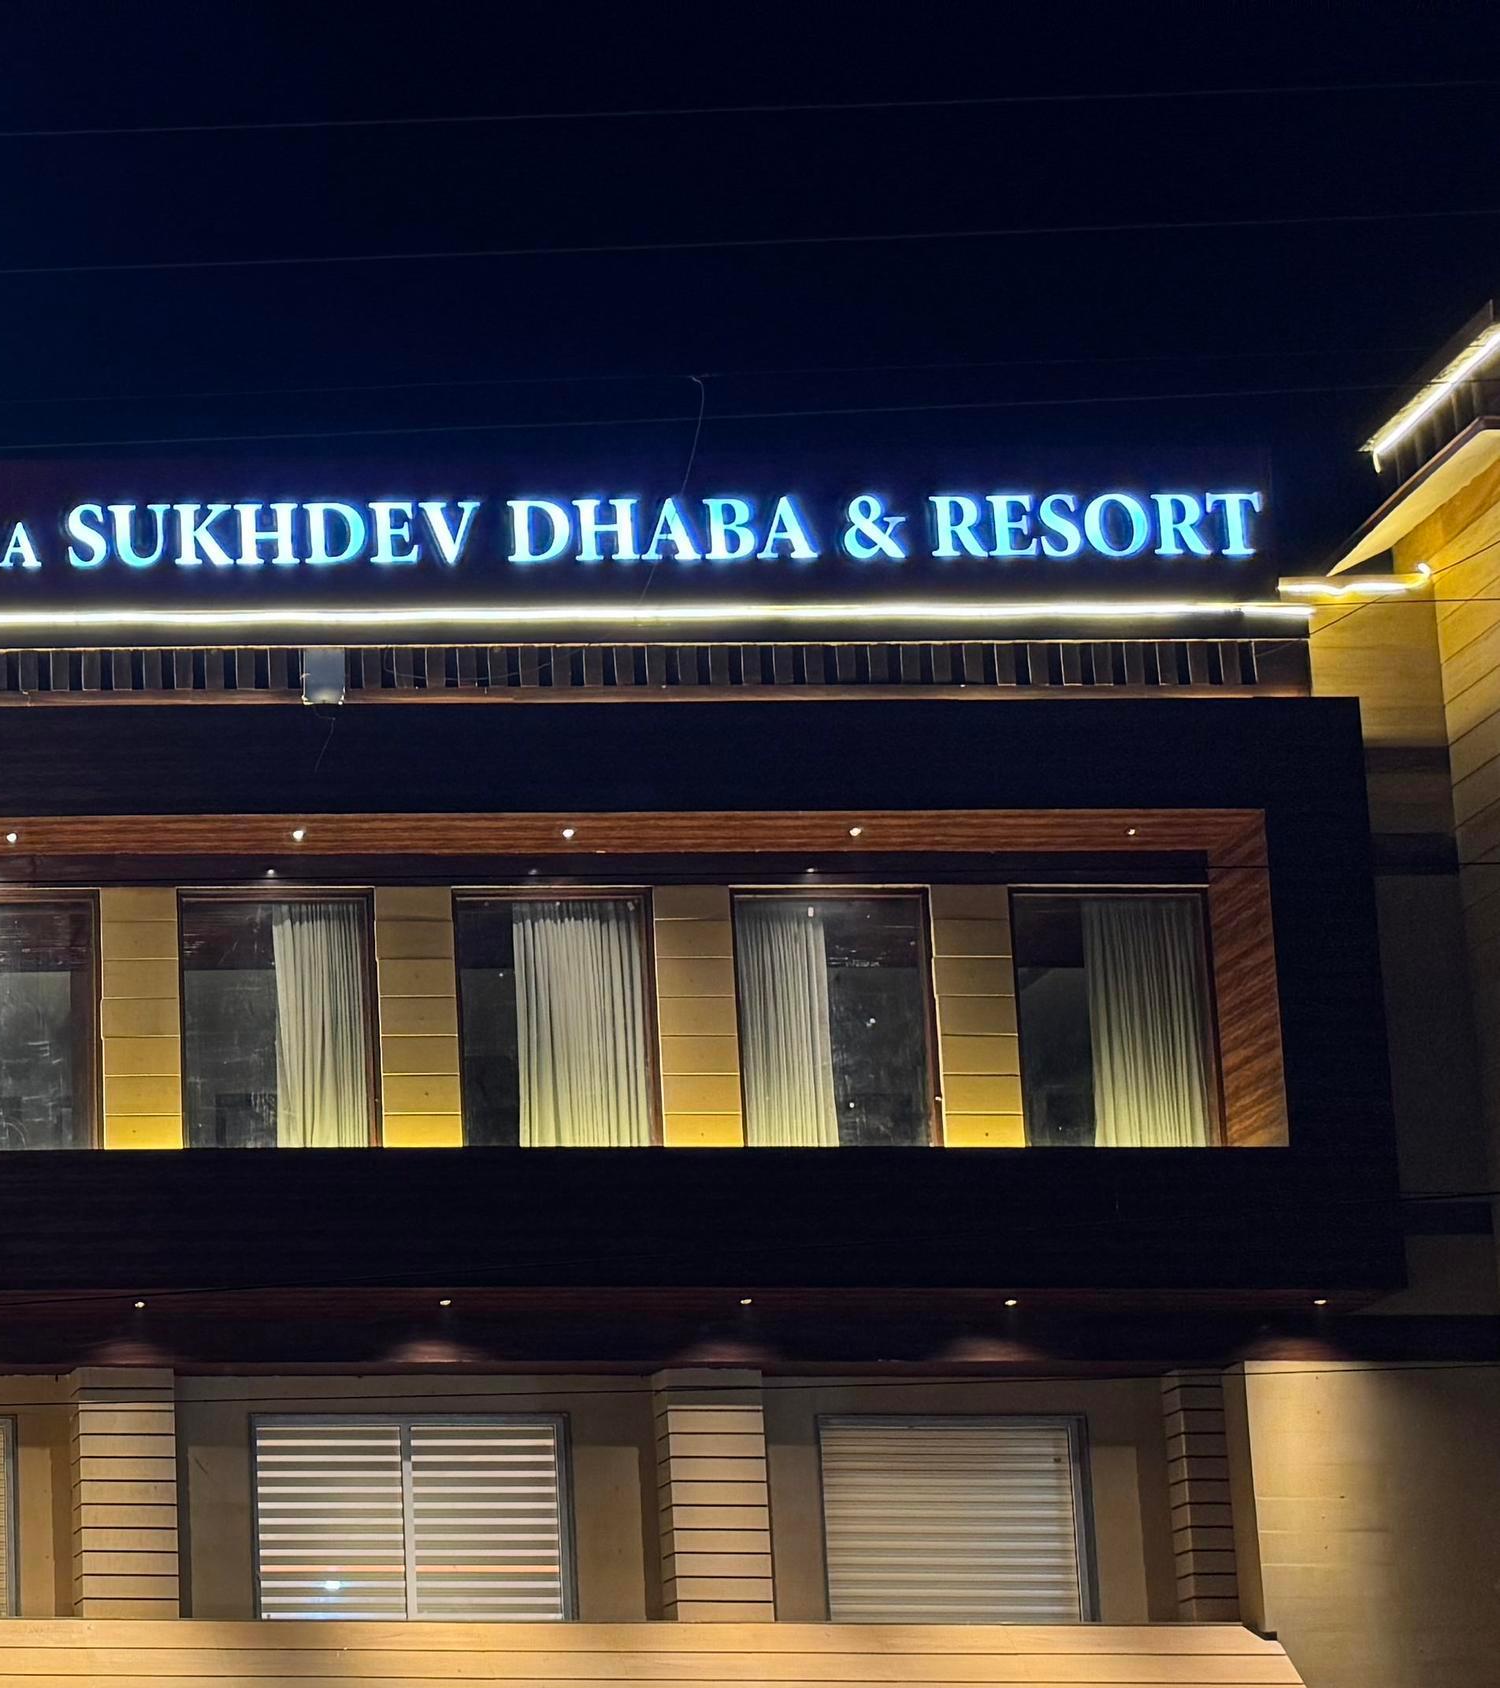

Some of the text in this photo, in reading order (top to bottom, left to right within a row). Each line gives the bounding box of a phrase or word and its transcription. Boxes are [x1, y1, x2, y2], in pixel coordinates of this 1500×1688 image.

[65, 501, 481, 570] SUKHDEV
[506, 496, 820, 566] DHABA
[843, 494, 906, 562] &
[928, 491, 1262, 560] RESORT
